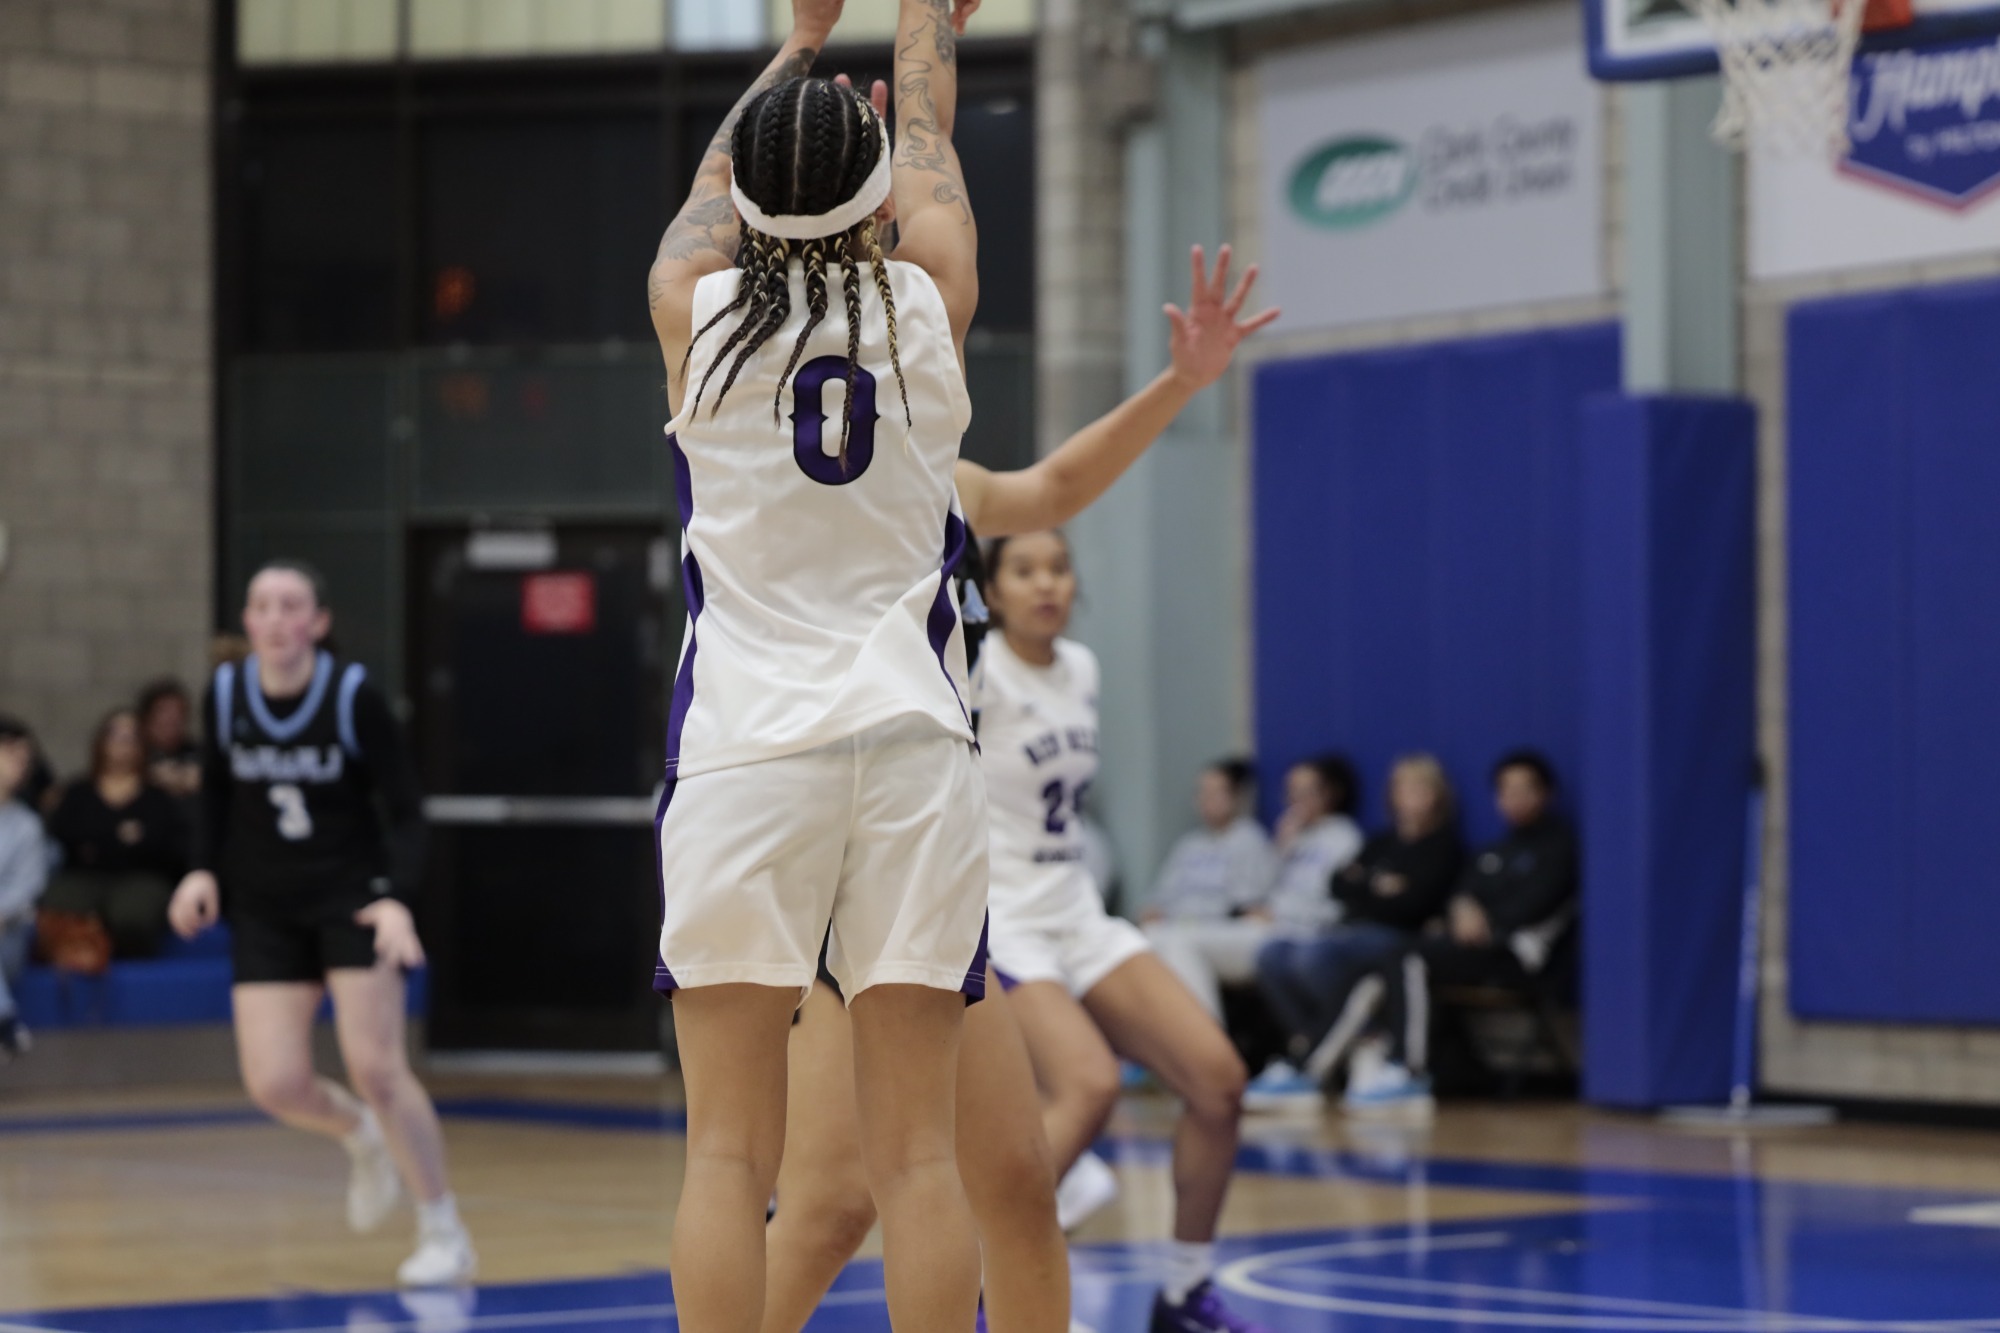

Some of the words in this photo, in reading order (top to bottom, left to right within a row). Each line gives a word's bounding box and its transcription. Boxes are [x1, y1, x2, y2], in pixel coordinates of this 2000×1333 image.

[1850, 36, 2000, 141] Hamp
[787, 354, 881, 485] 0
[267, 782, 314, 840] 3
